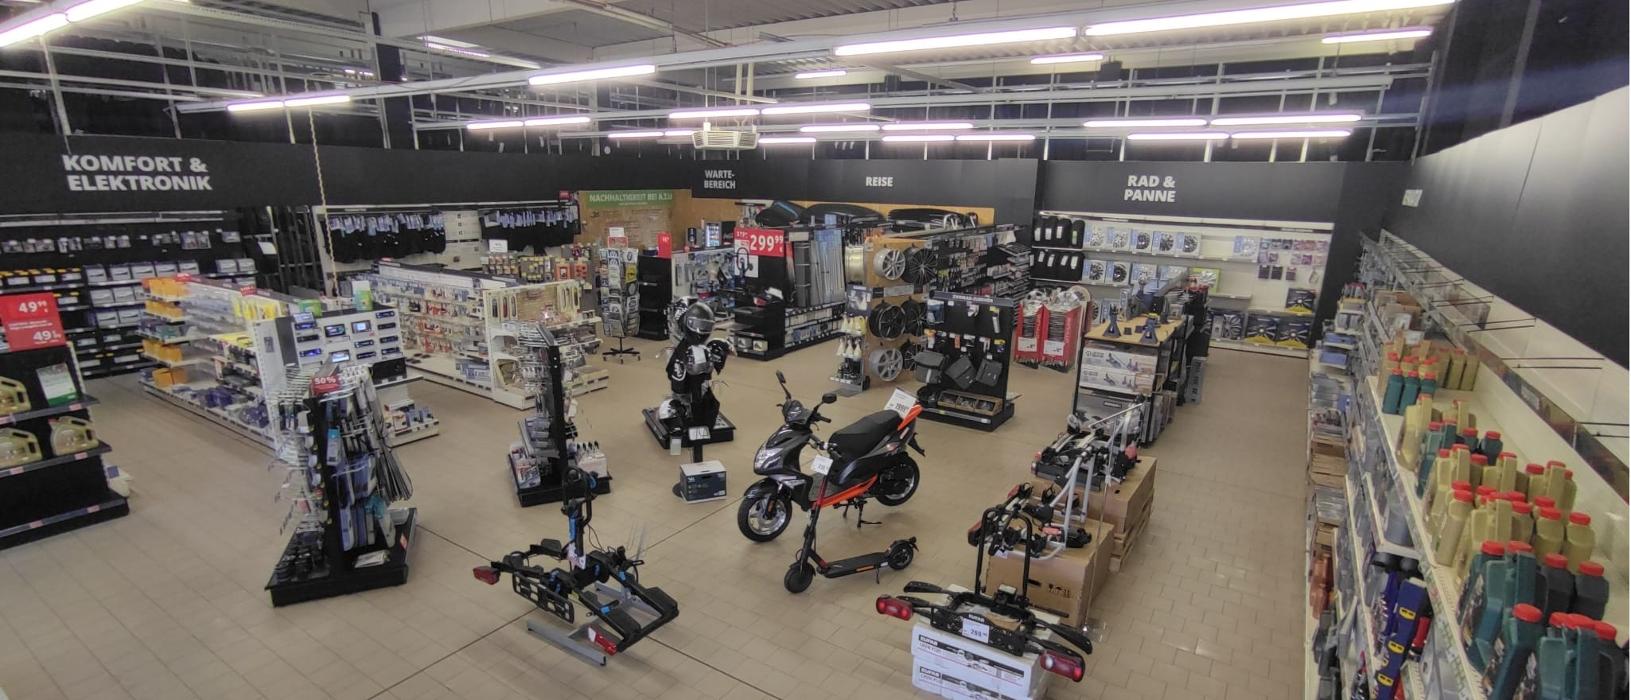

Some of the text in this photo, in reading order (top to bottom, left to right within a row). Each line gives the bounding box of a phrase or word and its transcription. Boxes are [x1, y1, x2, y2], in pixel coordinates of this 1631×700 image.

[62, 155, 208, 172] KOMFORT &
[704, 169, 735, 179] WARTE-
[67, 174, 212, 191] ELEKTRONIK
[703, 180, 736, 189] BEREICH
[865, 176, 894, 187] REISE
[1127, 174, 1176, 188] RAD &
[1124, 189, 1176, 202] PANNE
